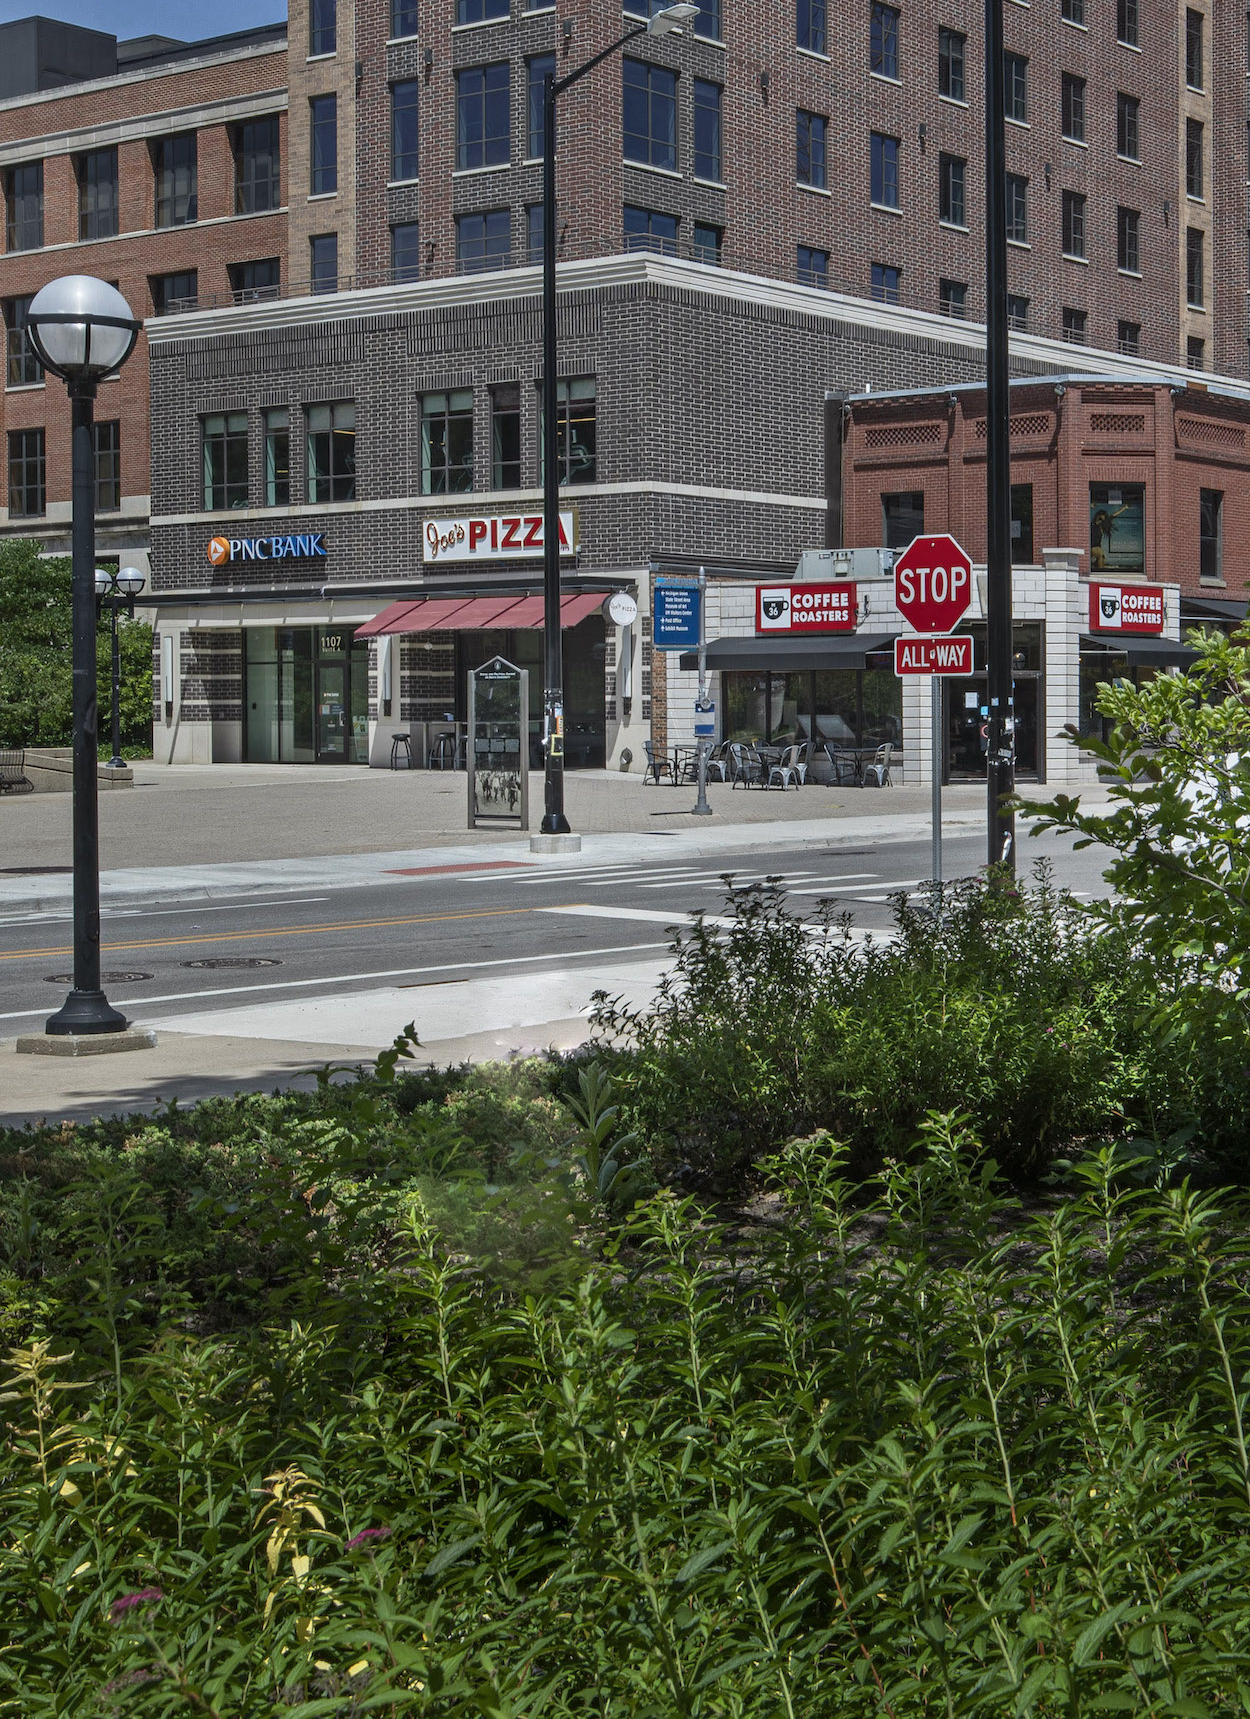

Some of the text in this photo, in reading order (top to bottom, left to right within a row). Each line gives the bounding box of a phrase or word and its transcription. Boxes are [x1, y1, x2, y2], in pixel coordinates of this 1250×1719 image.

[229, 534, 327, 560] PNC BANK
[426, 522, 465, 556] Joe's
[899, 566, 967, 604] STOP
[792, 592, 849, 608] COFFEE
[1122, 594, 1161, 610] COFFEE
[768, 608, 778, 616] 36
[792, 610, 849, 622] ROASTERS
[1105, 606, 1113, 615] 36
[1122, 611, 1161, 624] ROASTERS
[321, 636, 341, 647] 1107
[901, 644, 967, 667] ALL WAY
